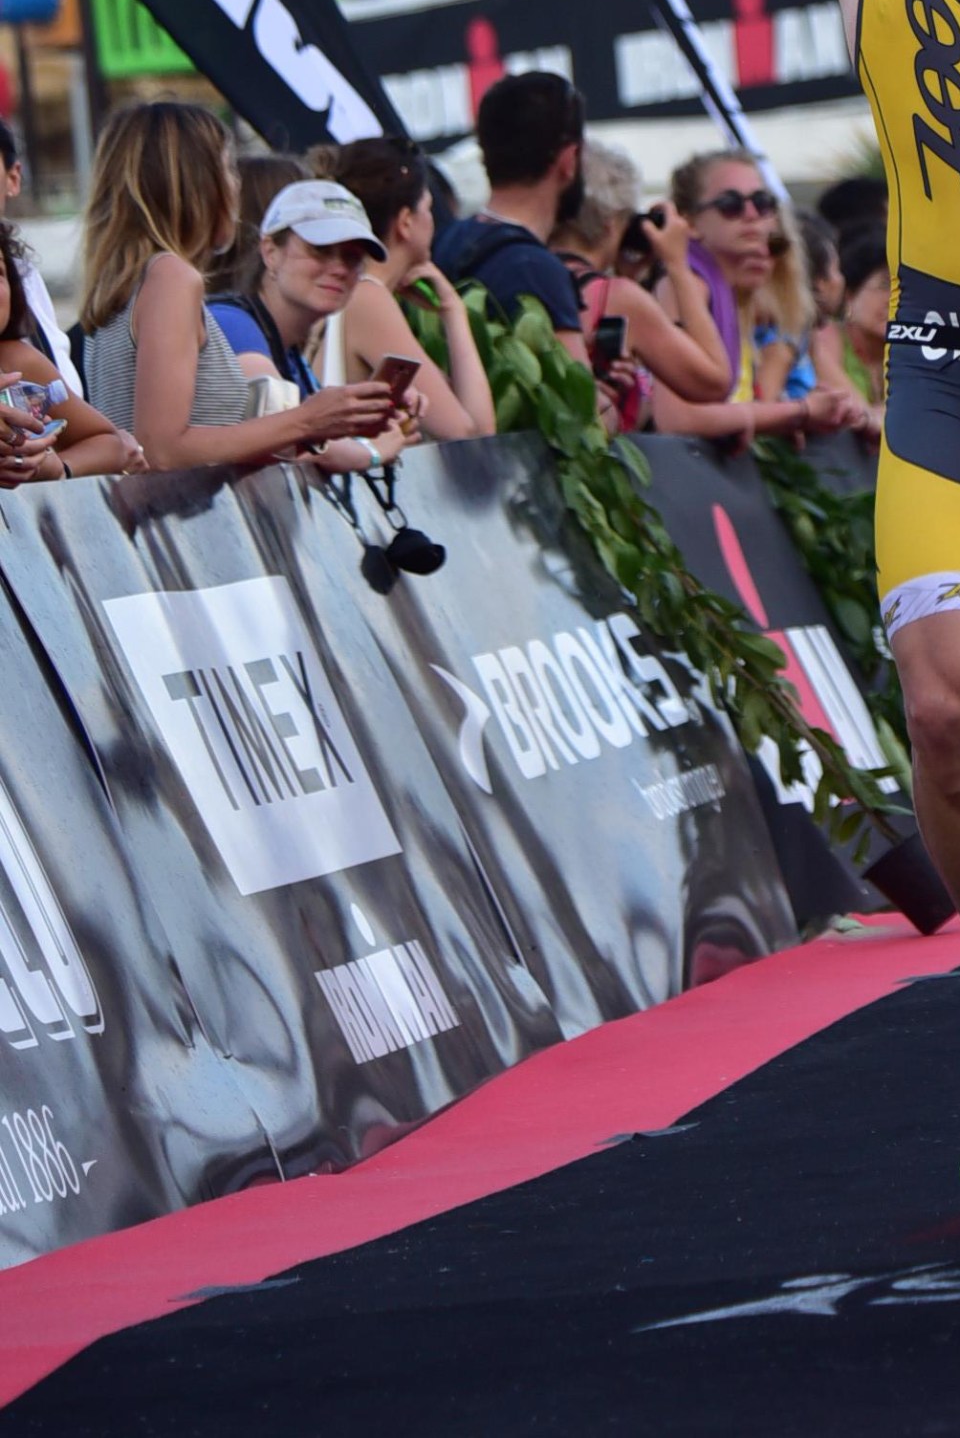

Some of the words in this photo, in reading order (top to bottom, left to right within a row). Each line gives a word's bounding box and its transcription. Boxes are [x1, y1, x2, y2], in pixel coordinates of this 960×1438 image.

[887, 324, 938, 342] 2XU
[161, 651, 355, 812] TIMEX
[471, 612, 690, 780] BROOKS
[313, 902, 462, 1065] IRONMAN
[1, 1104, 81, 1204] 1886
